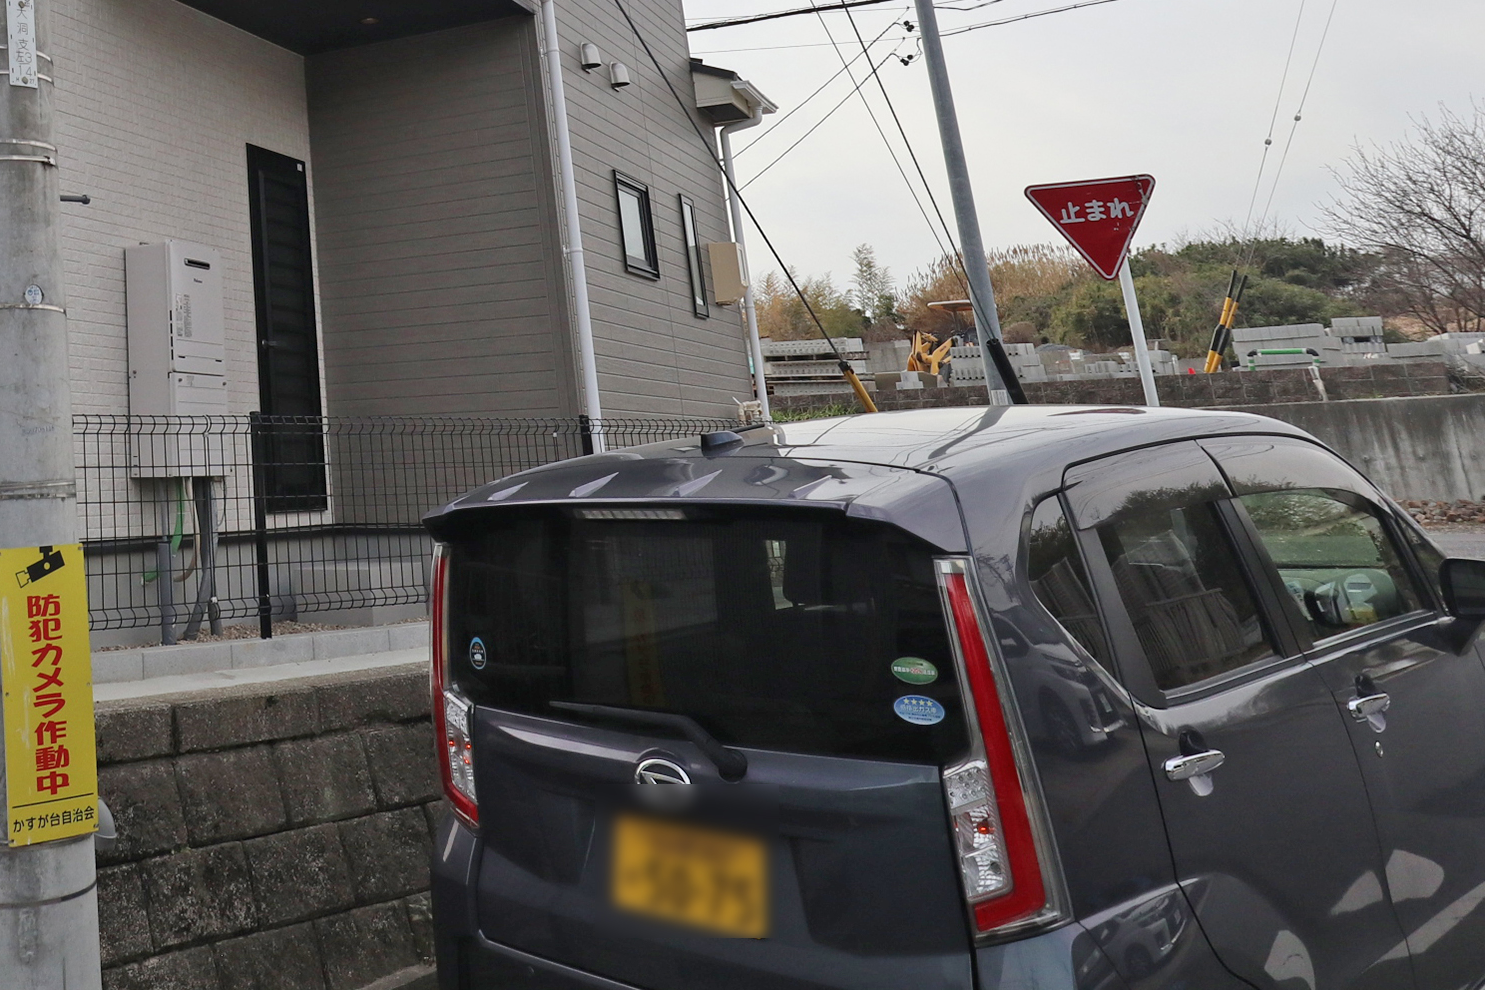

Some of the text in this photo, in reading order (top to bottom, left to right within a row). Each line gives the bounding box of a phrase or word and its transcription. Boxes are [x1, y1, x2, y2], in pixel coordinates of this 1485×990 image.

[1059, 197, 1135, 224] 止まれ
[27, 595, 70, 796] 防犯カメラ作動中
[13, 805, 95, 833] かすが台自治会
